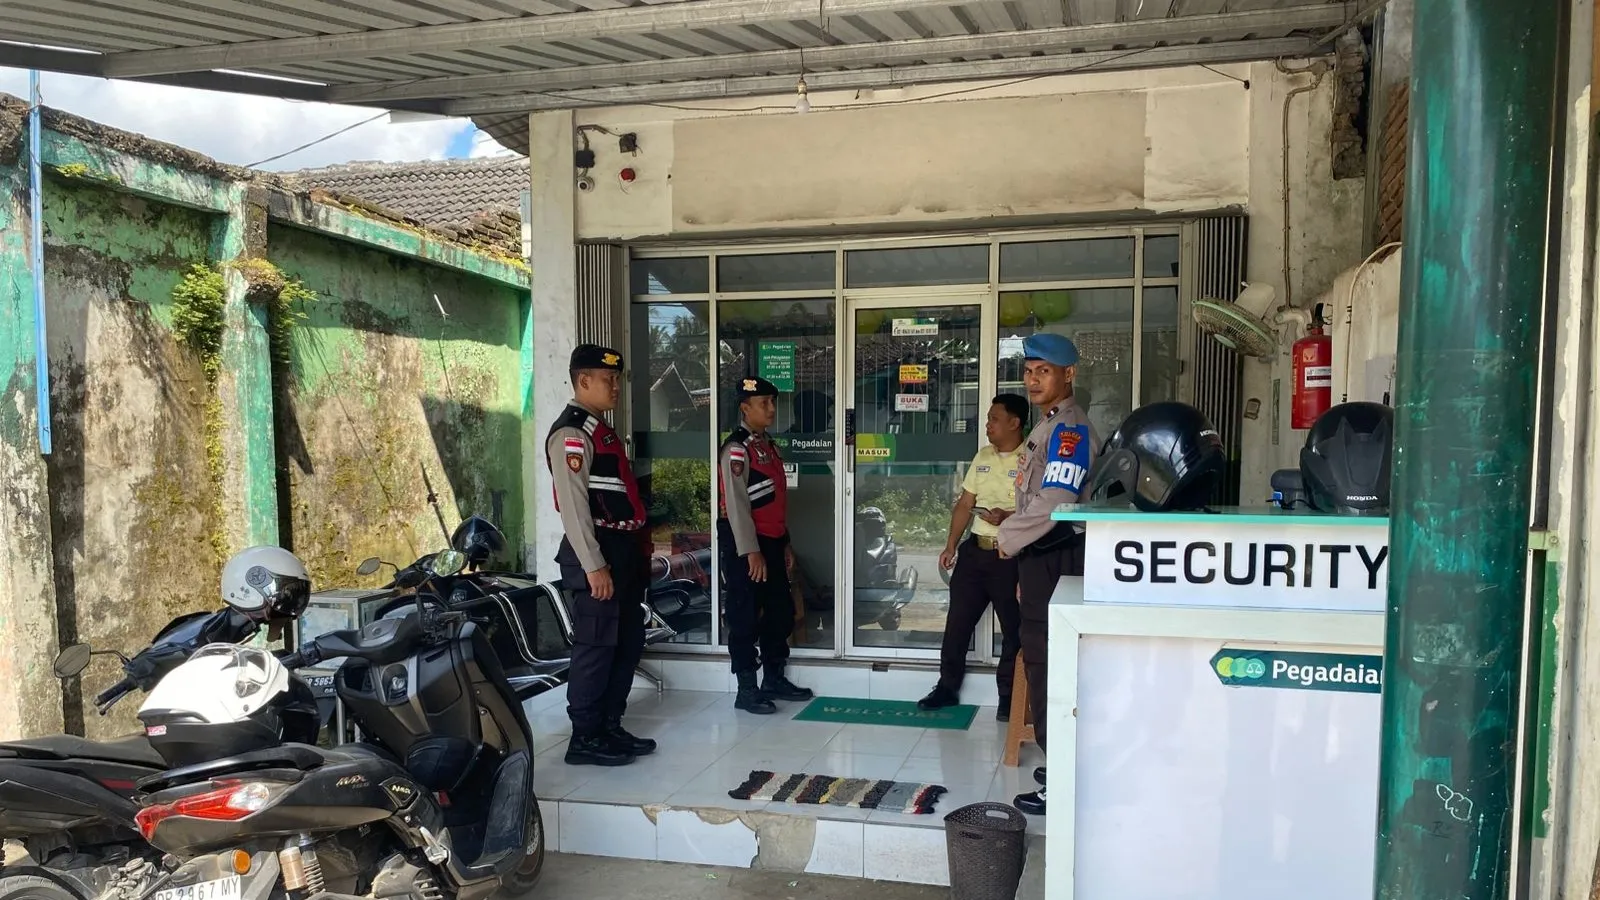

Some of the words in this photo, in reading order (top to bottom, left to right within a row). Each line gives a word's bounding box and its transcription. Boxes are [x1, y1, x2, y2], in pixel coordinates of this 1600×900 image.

[791, 438, 833, 449] Pegadaian
[1041, 460, 1087, 490] PROV
[1346, 494, 1379, 502] HONDA
[1113, 540, 1389, 590] SECURITY
[1272, 659, 1383, 686] Pegadaia
[177, 882, 216, 900] 2967
[220, 876, 240, 896] MY
